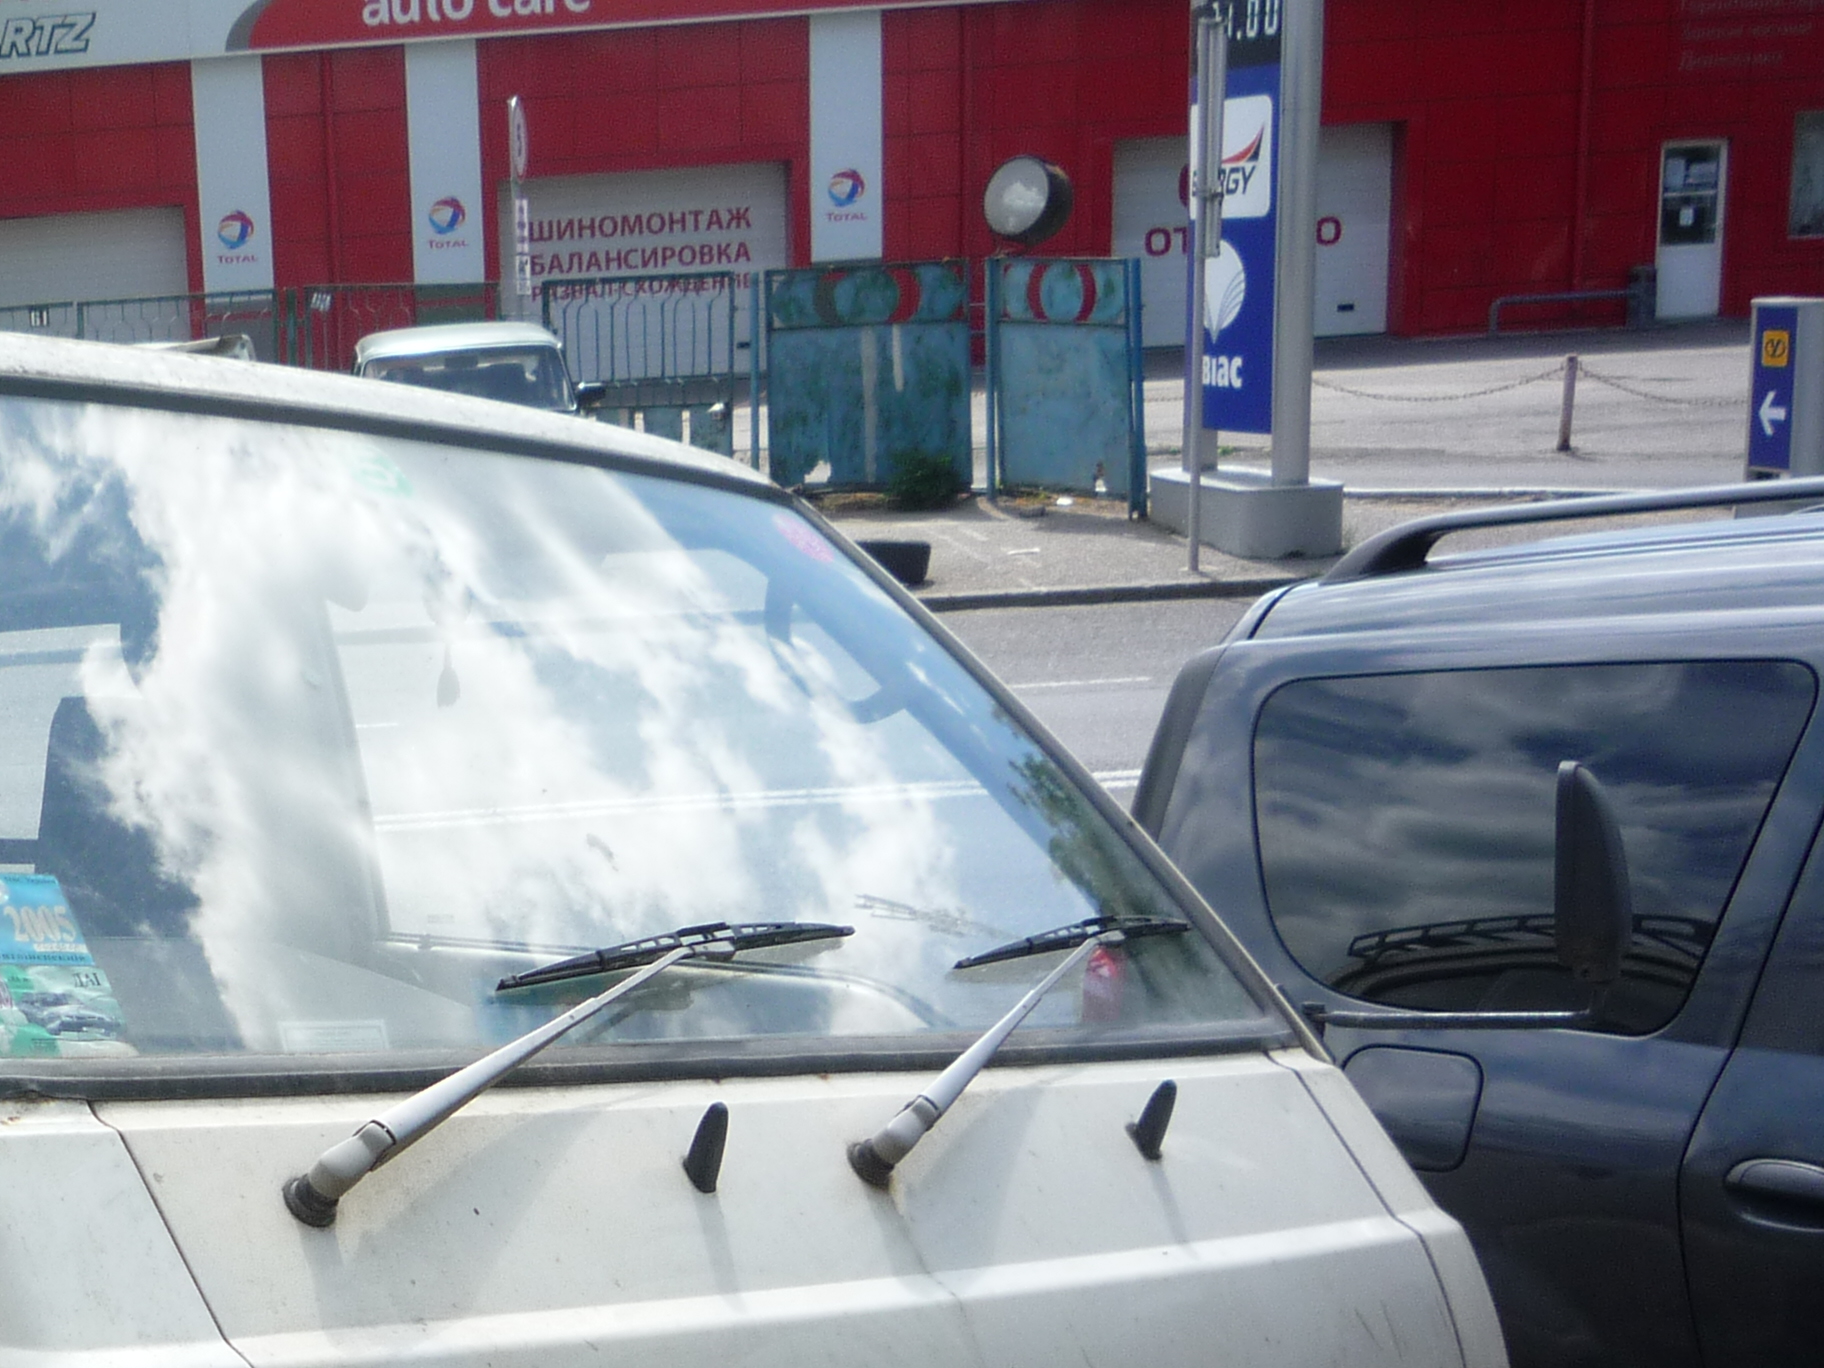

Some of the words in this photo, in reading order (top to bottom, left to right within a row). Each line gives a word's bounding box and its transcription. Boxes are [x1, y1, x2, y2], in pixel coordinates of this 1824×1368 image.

[826, 212, 868, 221] TOTAL
[528, 206, 752, 243] ШИНОМОНТАЖ
[428, 239, 470, 249] TOTAL
[217, 255, 257, 264] TOTAL
[530, 241, 752, 277] БАЛАНСИРОВКА
